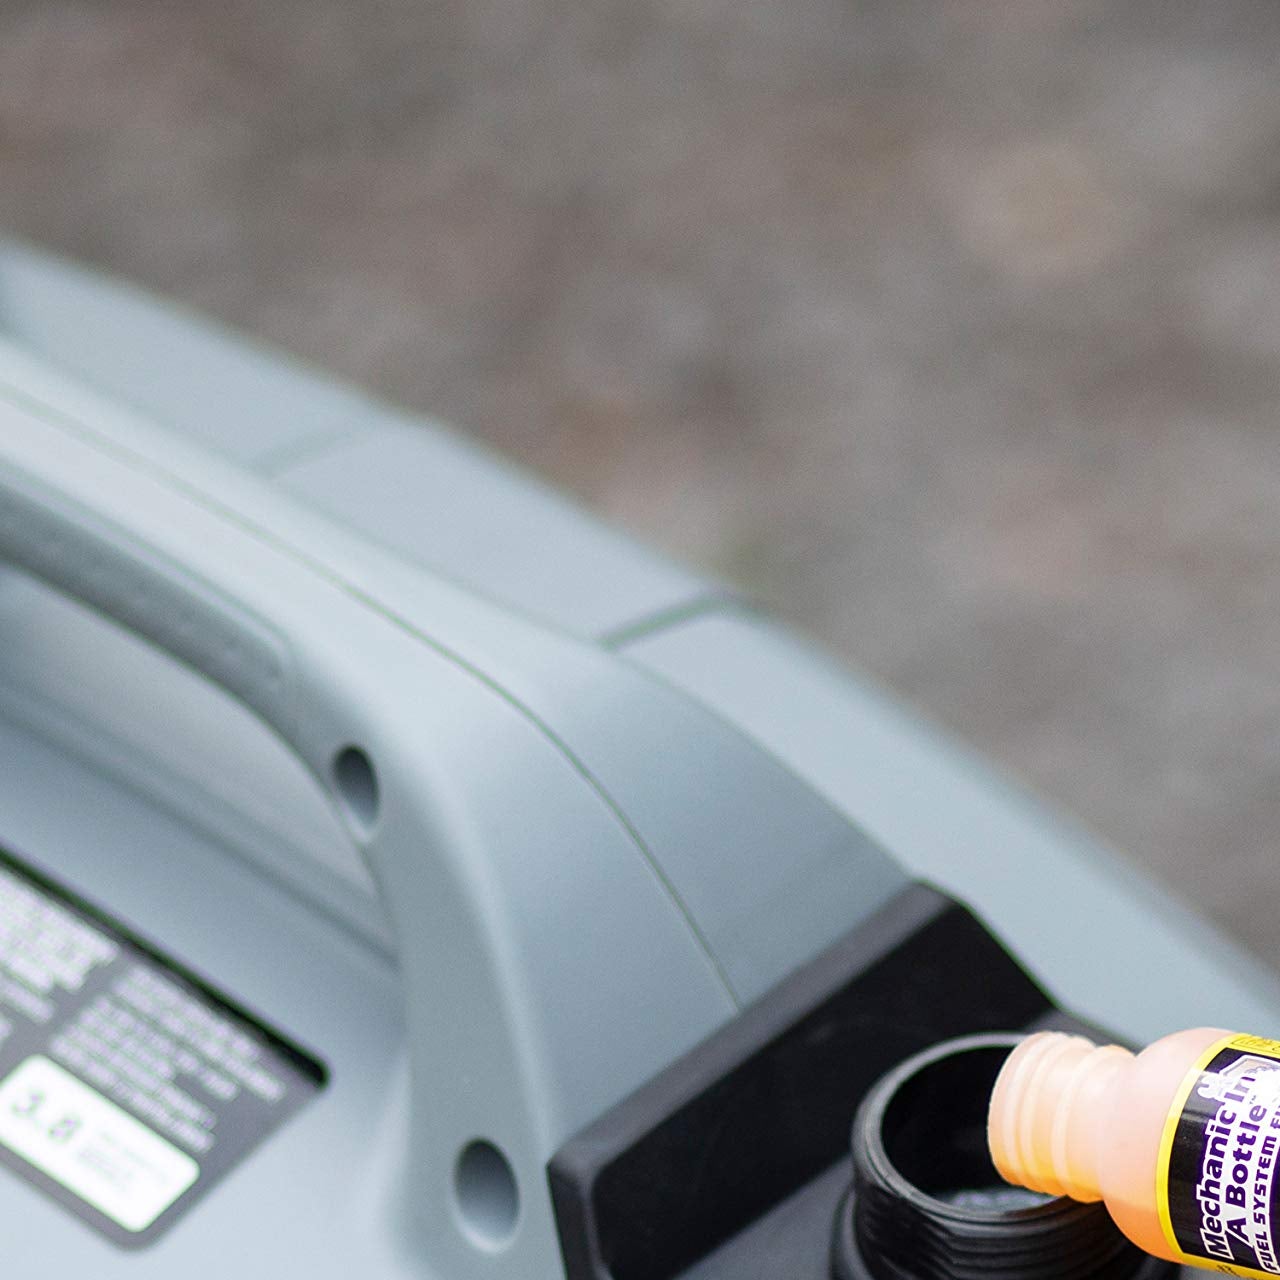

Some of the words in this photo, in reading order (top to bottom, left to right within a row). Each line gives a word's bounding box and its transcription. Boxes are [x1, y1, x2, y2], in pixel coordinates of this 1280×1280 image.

[1199, 1110, 1237, 1258] Mechanic
[1224, 1076, 1256, 1102] In
[1225, 1105, 1267, 1209] Bottle
[1253, 1135, 1277, 1225] SYSTEM
[1226, 1218, 1251, 1244] A
[1255, 1231, 1279, 1271] FUEL
